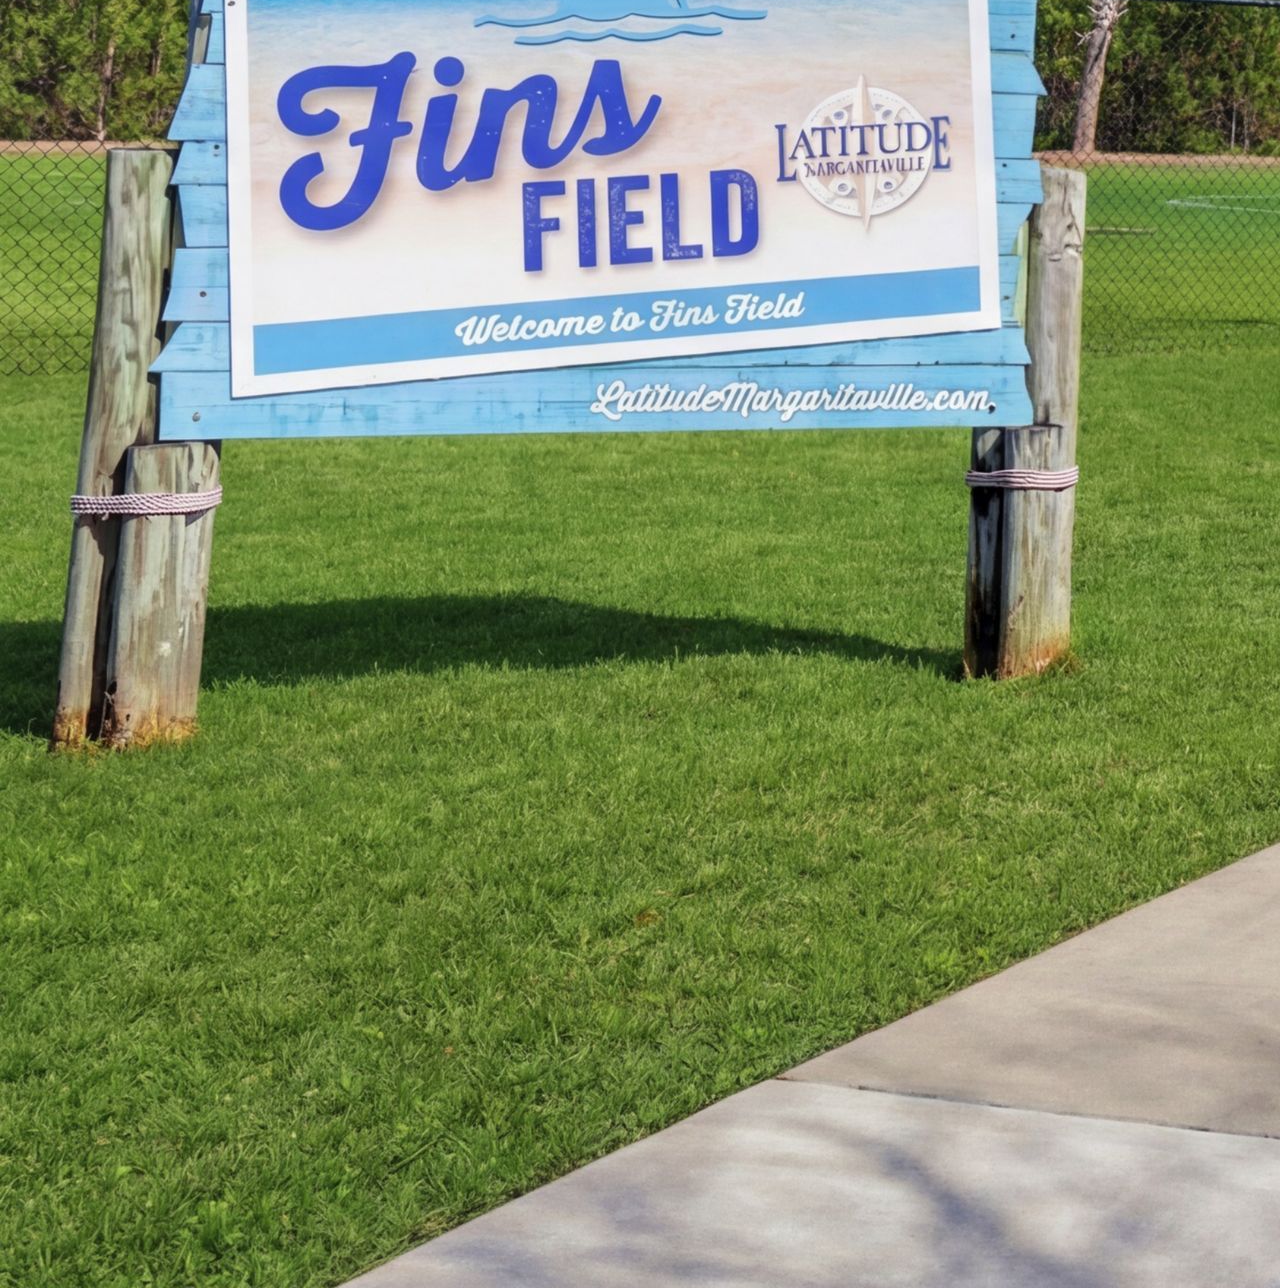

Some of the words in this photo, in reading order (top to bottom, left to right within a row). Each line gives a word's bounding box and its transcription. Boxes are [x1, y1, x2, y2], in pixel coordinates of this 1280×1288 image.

[277, 51, 662, 231] Fins
[775, 116, 952, 182] LATITUDE
[523, 169, 760, 272] FIELD
[455, 314, 605, 346] Welcome
[611, 307, 645, 332] to
[650, 299, 718, 332] Fins
[724, 292, 805, 324] Field
